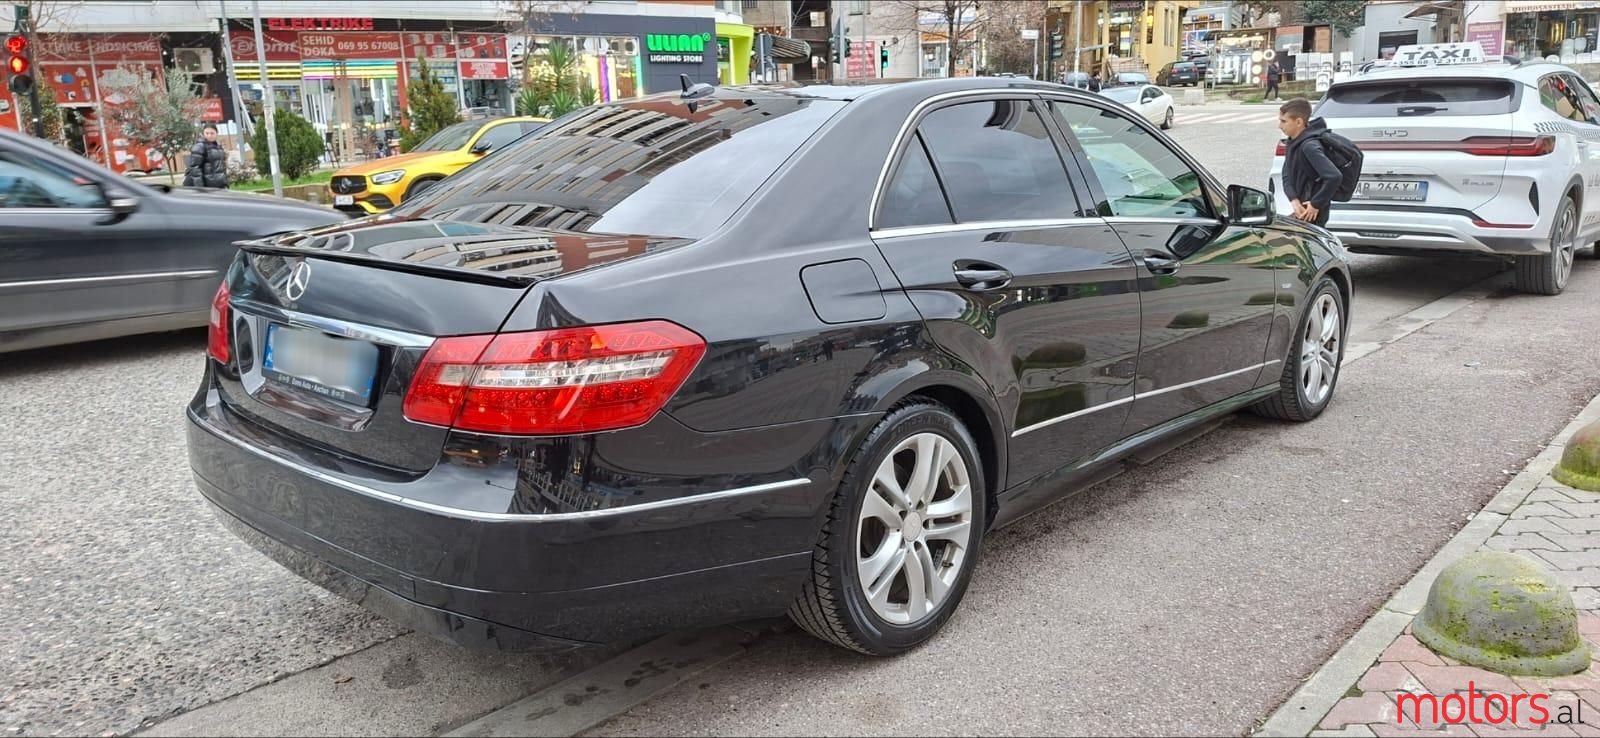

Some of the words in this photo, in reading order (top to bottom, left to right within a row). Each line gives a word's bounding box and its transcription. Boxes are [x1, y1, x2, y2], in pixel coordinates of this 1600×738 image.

[267, 18, 373, 29] ELEKTRIKE
[303, 36, 334, 46] SEHID
[337, 41, 355, 50] 069
[357, 41, 369, 50] 95
[304, 48, 336, 56] DOKA
[1403, 48, 1471, 60] TAXI
[1372, 130, 1409, 138] BYD
